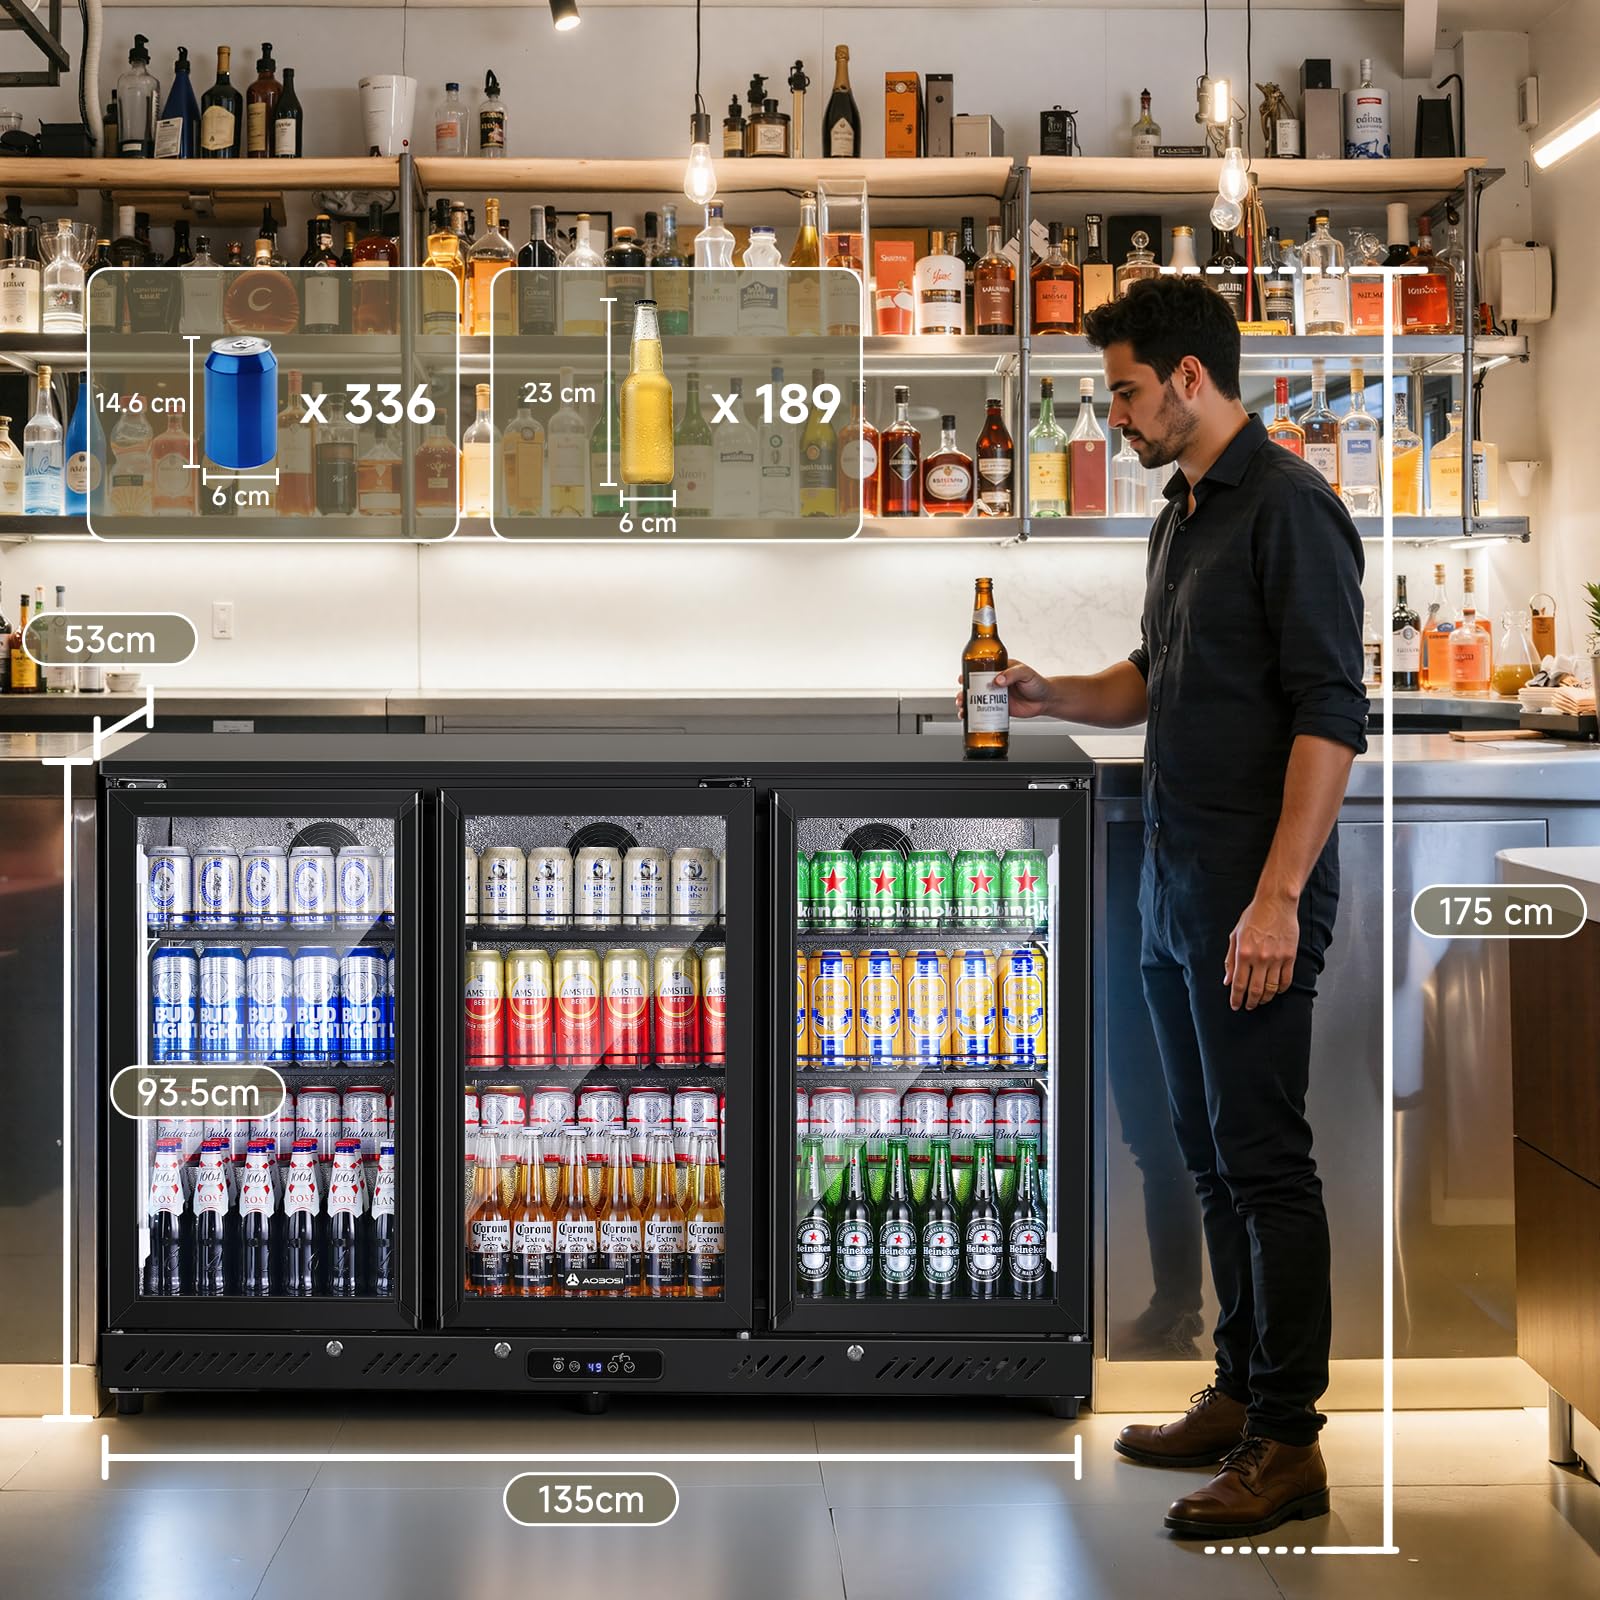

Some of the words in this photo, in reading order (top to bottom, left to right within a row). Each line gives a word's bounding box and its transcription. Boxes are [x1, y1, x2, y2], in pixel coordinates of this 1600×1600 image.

[467, 989, 497, 997] AMSTEL
[514, 989, 545, 997] AMSTEL
[563, 988, 594, 996] AMSTEL
[611, 987, 643, 995] AMSTEL
[662, 987, 693, 995] AMSTEL
[155, 1007, 195, 1022] BUD
[200, 1007, 238, 1022] BUD
[248, 1006, 288, 1022] BUD
[297, 1006, 337, 1022] BUD
[342, 1006, 381, 1022] BUD
[200, 1023, 244, 1039] IGHT
[154, 1171, 176, 1183] 1664
[200, 1171, 221, 1182] 1664
[246, 1172, 267, 1184] 1664
[290, 1171, 312, 1183] 1664
[334, 1172, 355, 1184] 1664
[472, 1222, 507, 1236] Corona
[515, 1223, 551, 1236] Corona
[558, 1222, 594, 1236] Corona
[602, 1223, 638, 1236] Corona
[646, 1223, 682, 1236] Corona
[688, 1223, 724, 1236] Corona
[481, 1234, 502, 1242] Extra
[524, 1234, 545, 1243] Extra
[567, 1233, 588, 1243] Extra
[610, 1234, 631, 1242] Extra
[656, 1234, 677, 1242] Extra
[697, 1234, 718, 1243] Extra
[836, 1246, 873, 1254] Heineken
[880, 1246, 917, 1255] Heineken
[923, 1246, 960, 1255] Heineken
[966, 1244, 1003, 1253] Heineken
[1009, 1245, 1046, 1254] Heineken
[588, 1362, 602, 1373] 49
